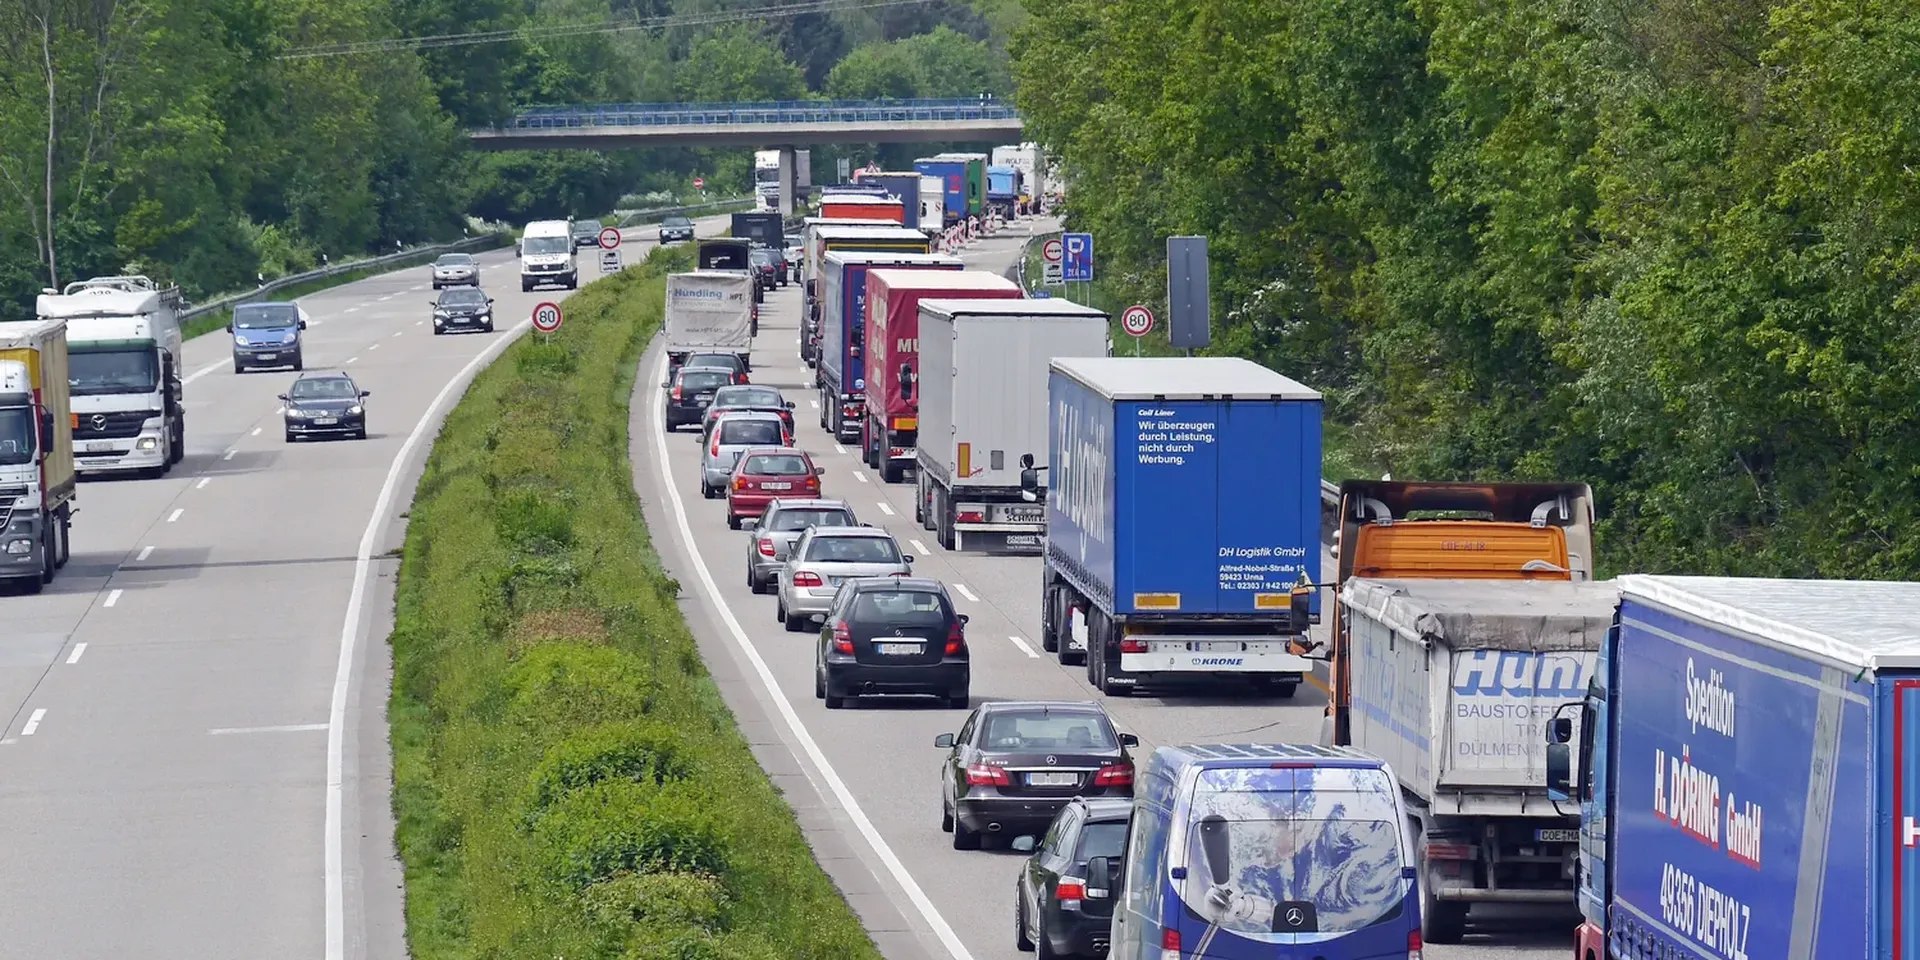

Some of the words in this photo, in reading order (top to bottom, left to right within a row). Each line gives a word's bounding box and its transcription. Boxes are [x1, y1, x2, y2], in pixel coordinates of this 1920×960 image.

[1068, 238, 1084, 262] P
[539, 310, 555, 323] 80
[1130, 314, 1145, 327] 80
[1138, 421, 1156, 430] Wir
[1157, 421, 1216, 431] überzeugen
[1138, 432, 1167, 441] durch
[1169, 432, 1216, 443] Leistung,
[1138, 443, 1164, 452] nicht
[1165, 443, 1194, 452] durch
[1138, 454, 1186, 465] Werbung.
[1219, 547, 1234, 557] DH
[1235, 547, 1272, 558] Logistik
[1273, 547, 1306, 557] GmbH
[1219, 564, 1295, 572] Alfred-Nobel-Straße
[1243, 573, 1264, 581] Unna
[1219, 582, 1236, 590] Tel.:
[1202, 658, 1244, 666] KRONE
[1685, 656, 1736, 738] Spedition
[1670, 744, 1720, 848] DÖRING
[1726, 792, 1762, 870] GmbH
[1542, 830, 1561, 840] COE
[1660, 862, 1695, 936] 49356
[1696, 881, 1750, 960] DIEPHOLZ
